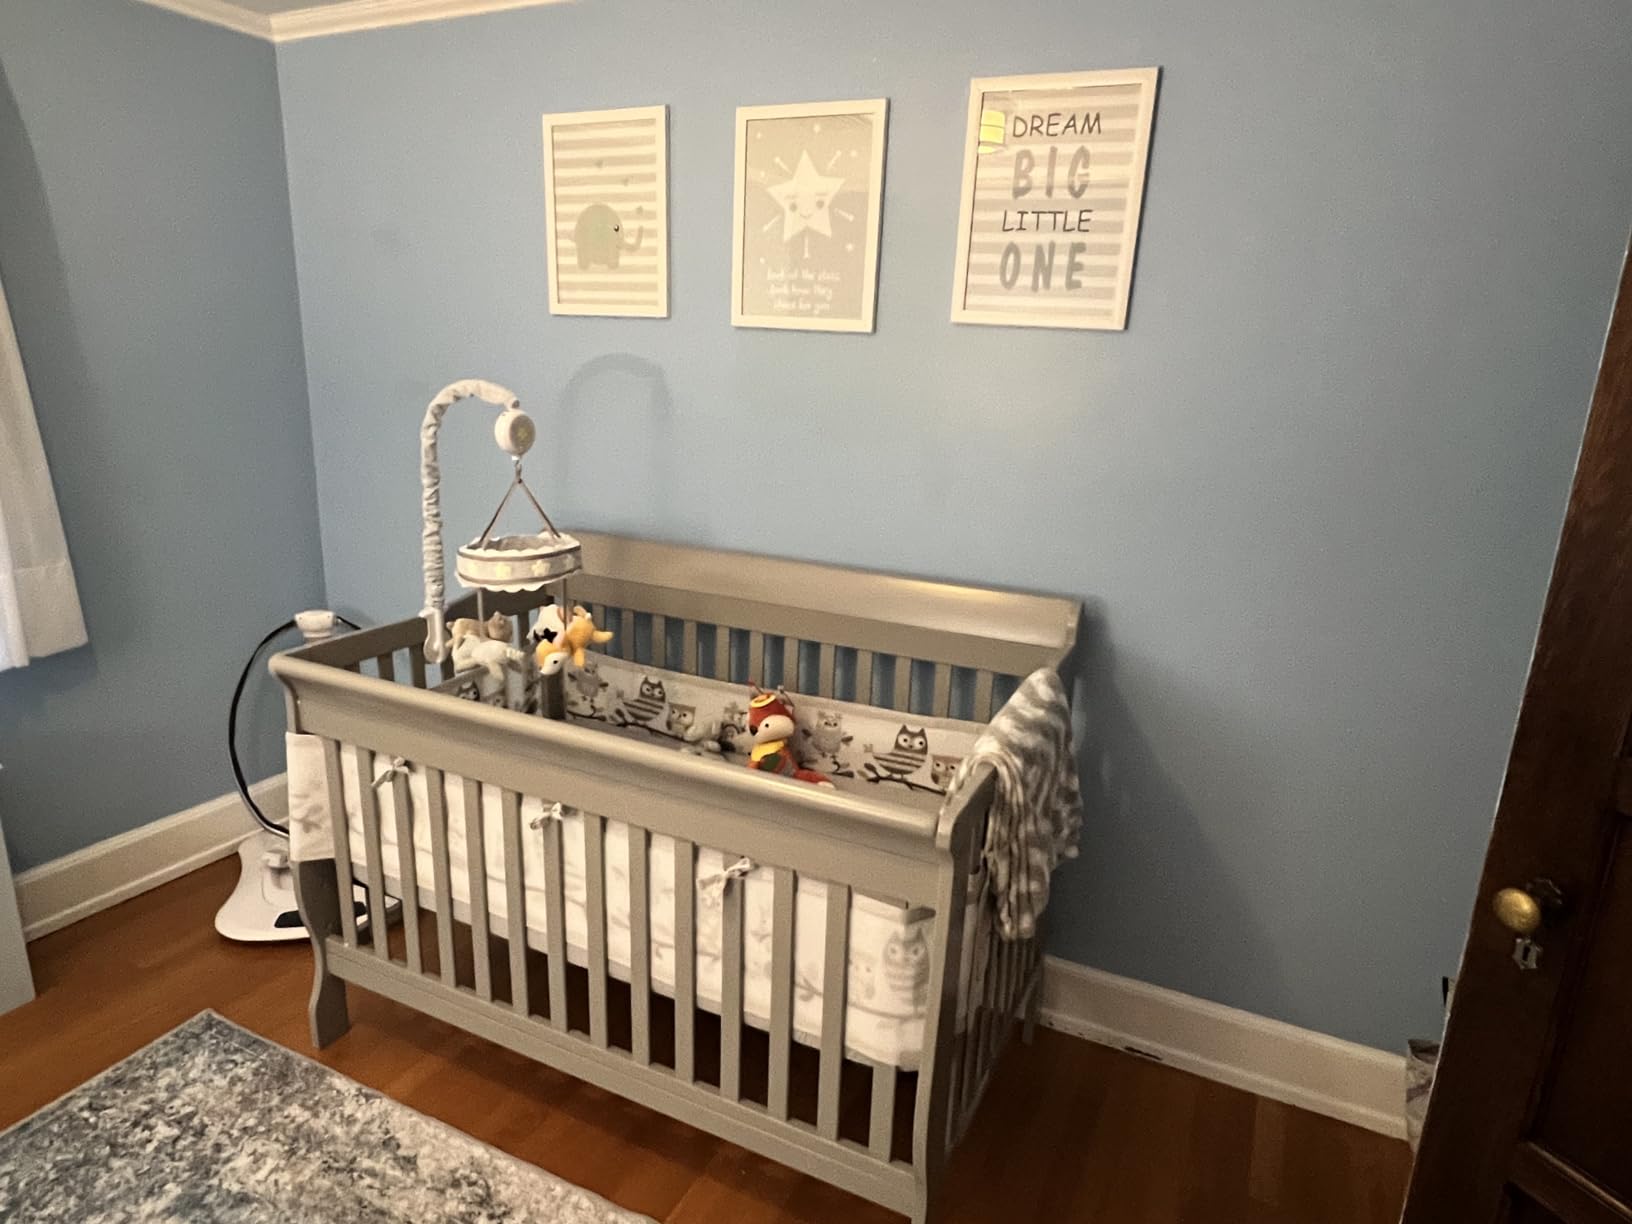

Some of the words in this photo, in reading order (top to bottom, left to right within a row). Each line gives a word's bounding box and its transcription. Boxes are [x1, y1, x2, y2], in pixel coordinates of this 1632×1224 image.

[1012, 112, 1102, 138] DREAM
[1012, 145, 1091, 199] BIG
[1001, 209, 1093, 232] LITTLE
[1000, 241, 1087, 292] ONE
